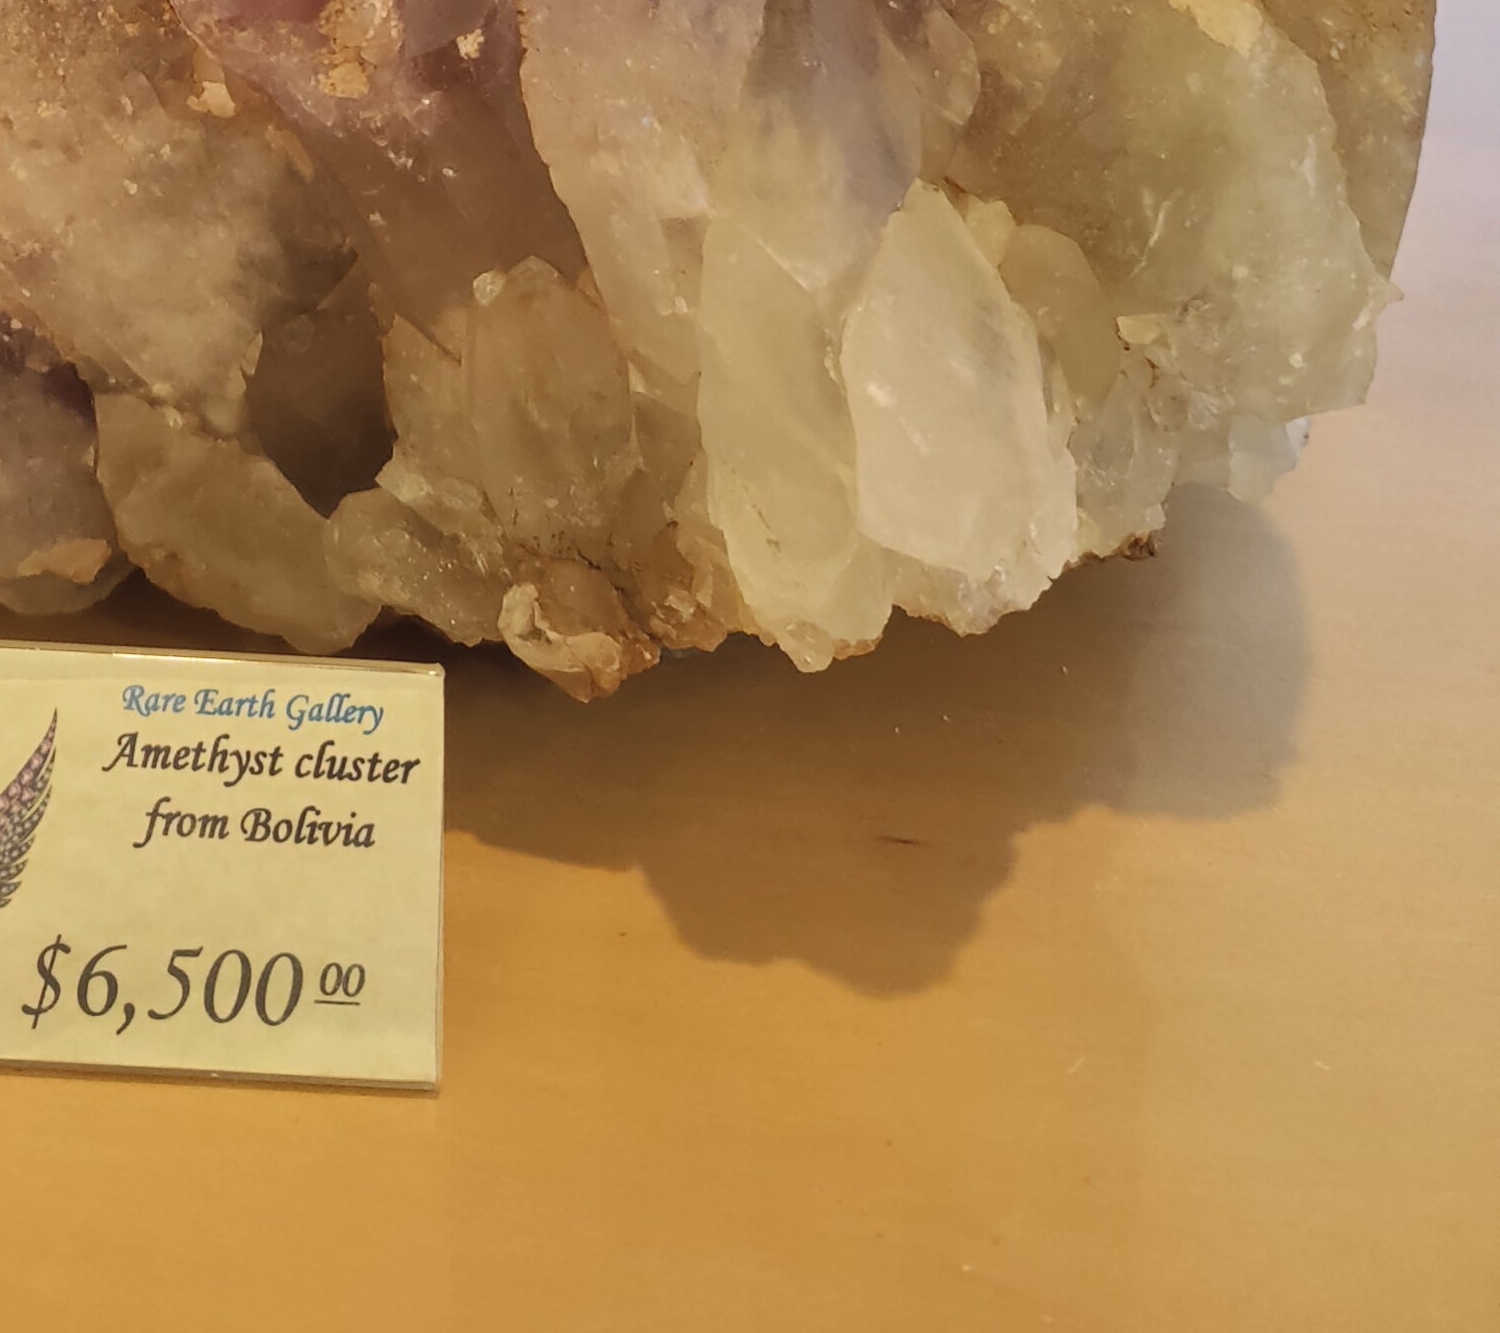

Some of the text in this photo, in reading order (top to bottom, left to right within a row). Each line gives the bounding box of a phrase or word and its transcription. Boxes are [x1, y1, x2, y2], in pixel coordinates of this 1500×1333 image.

[121, 684, 384, 735] Rare Earth Gallery
[101, 731, 421, 787] Amethyst cluster
[132, 796, 376, 849] from Bolivia
[20, 933, 304, 1036] $6,500
